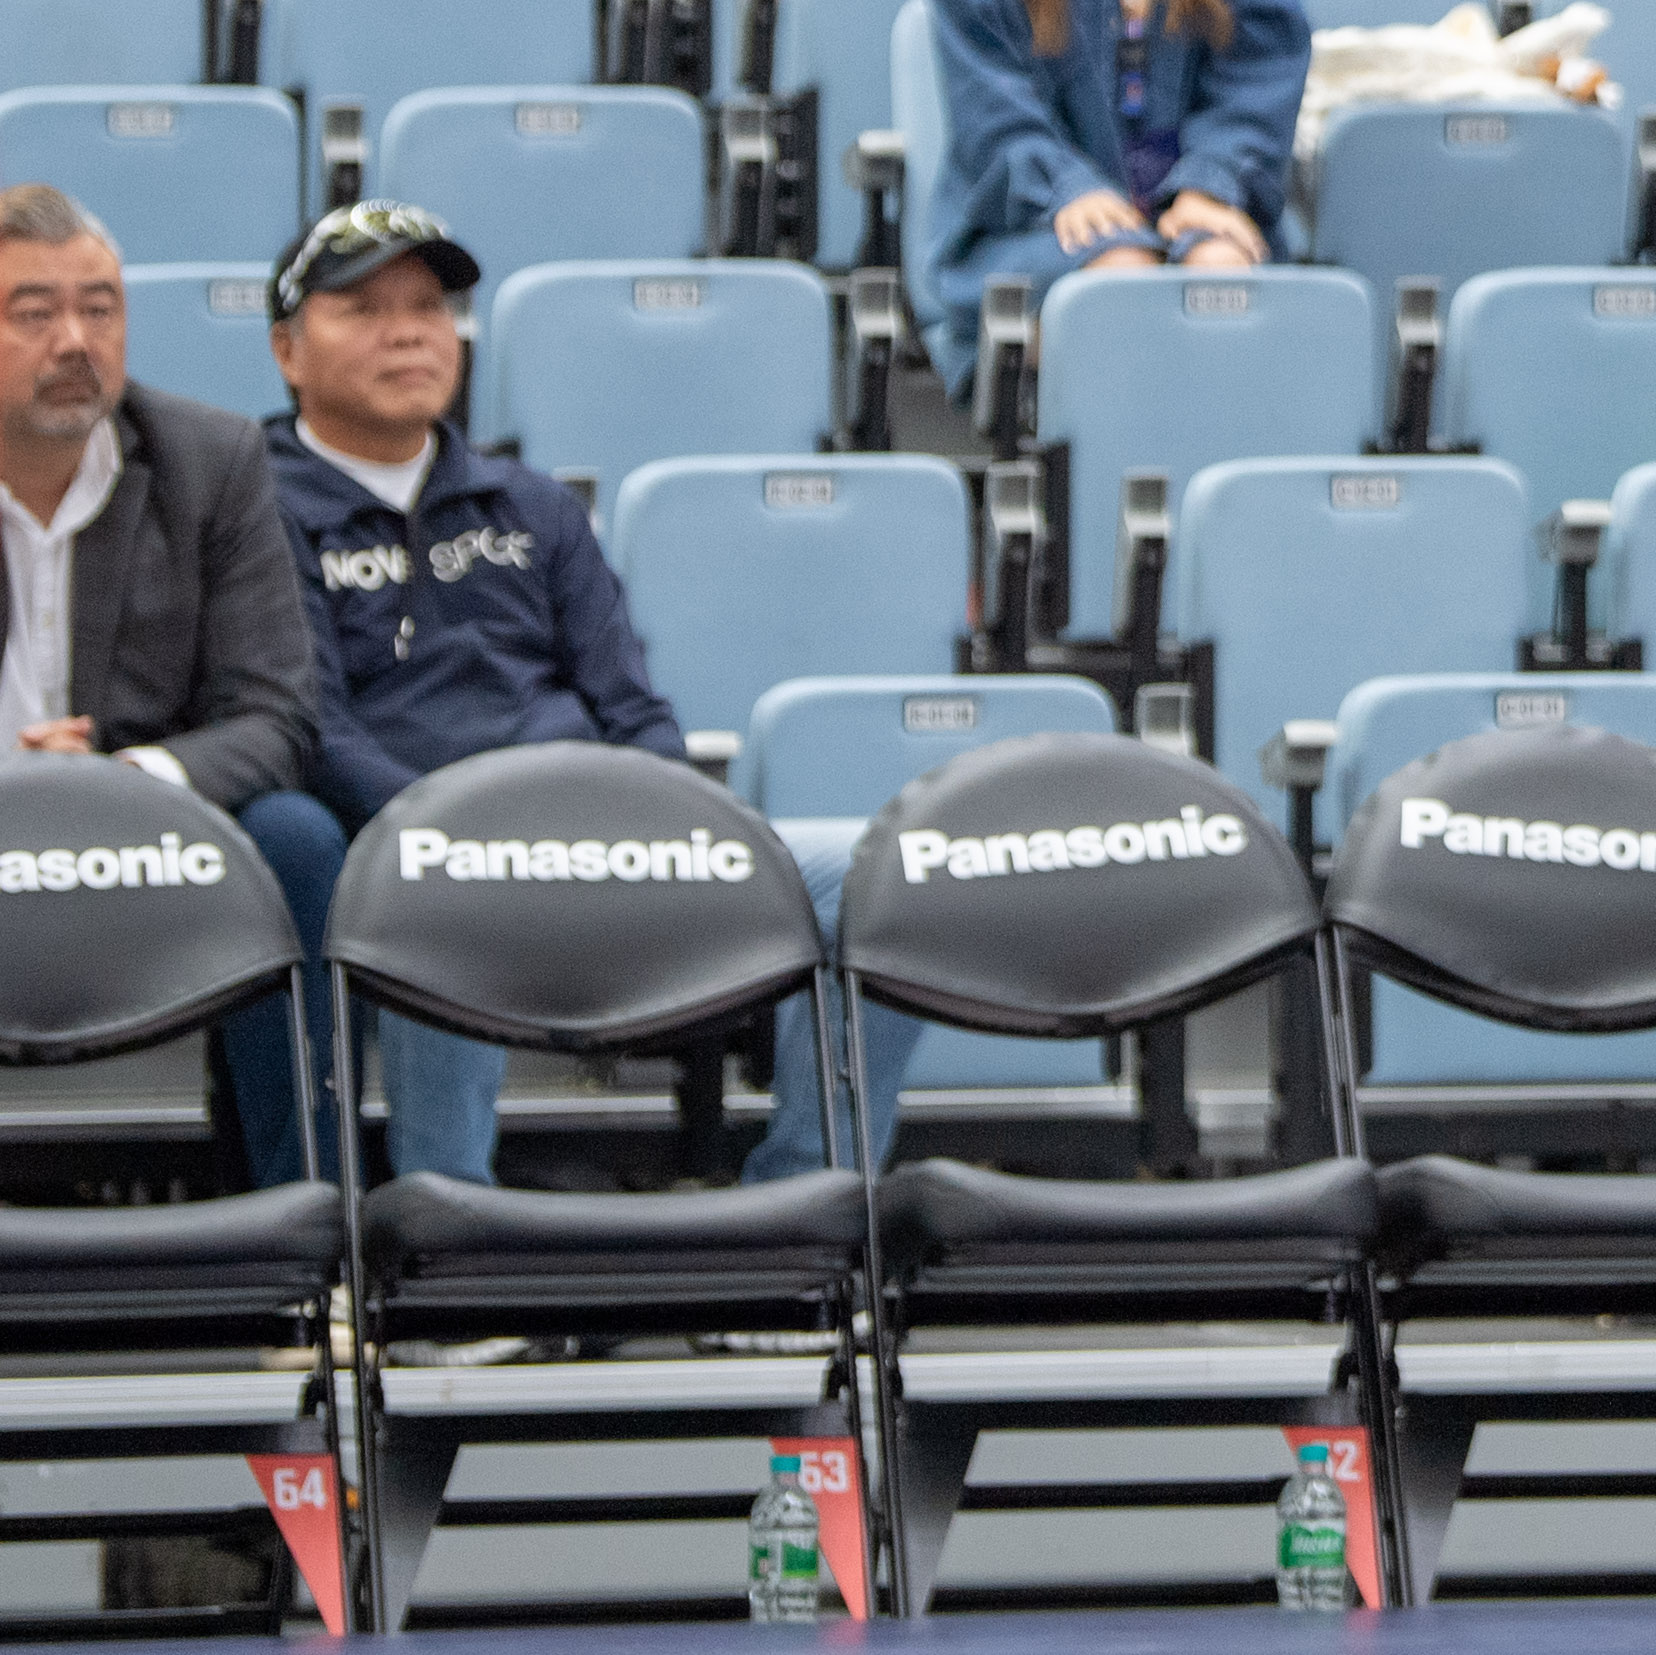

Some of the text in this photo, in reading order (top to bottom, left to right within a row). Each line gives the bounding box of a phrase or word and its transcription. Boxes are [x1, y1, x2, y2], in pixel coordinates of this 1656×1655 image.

[0, 831, 226, 893] asonic
[397, 828, 755, 884] Panasonic
[896, 804, 1247, 884] Panasonic
[273, 1467, 326, 1511] 64
[798, 1450, 849, 1493] 63
